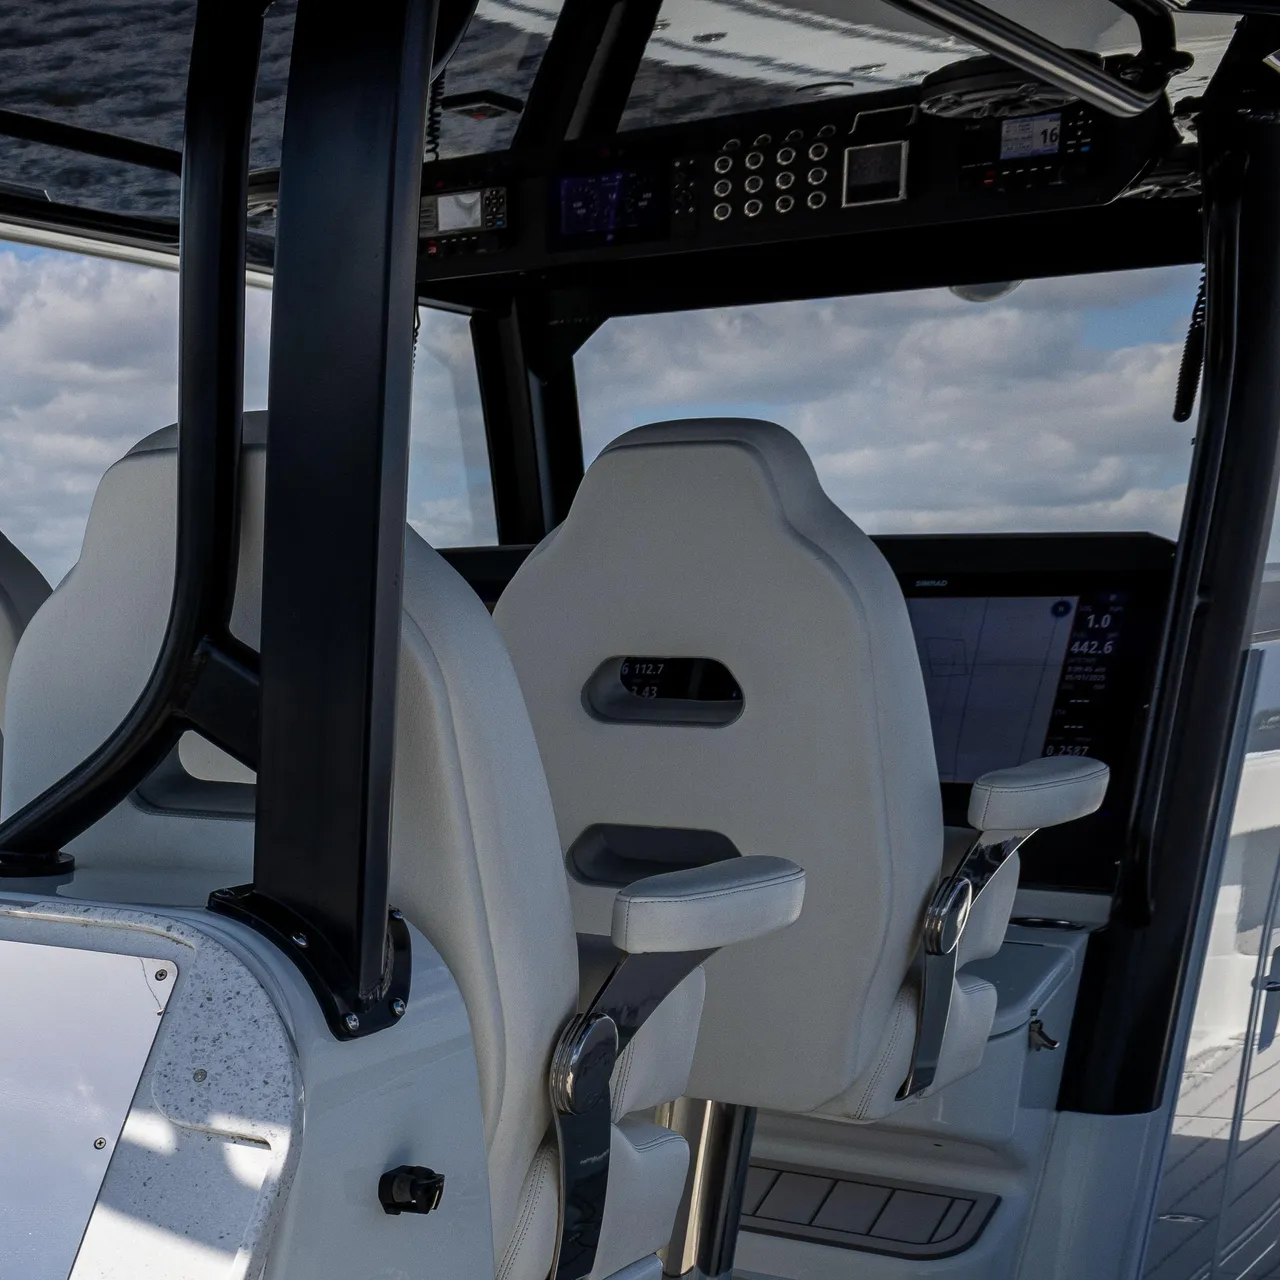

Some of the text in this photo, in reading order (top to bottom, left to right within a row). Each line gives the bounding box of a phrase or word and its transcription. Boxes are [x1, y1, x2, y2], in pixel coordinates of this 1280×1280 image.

[1040, 127, 1059, 144] 16
[1087, 614, 1111, 628] 1.0
[1070, 641, 1113, 654] 442.6
[635, 664, 664, 675] 112.7
